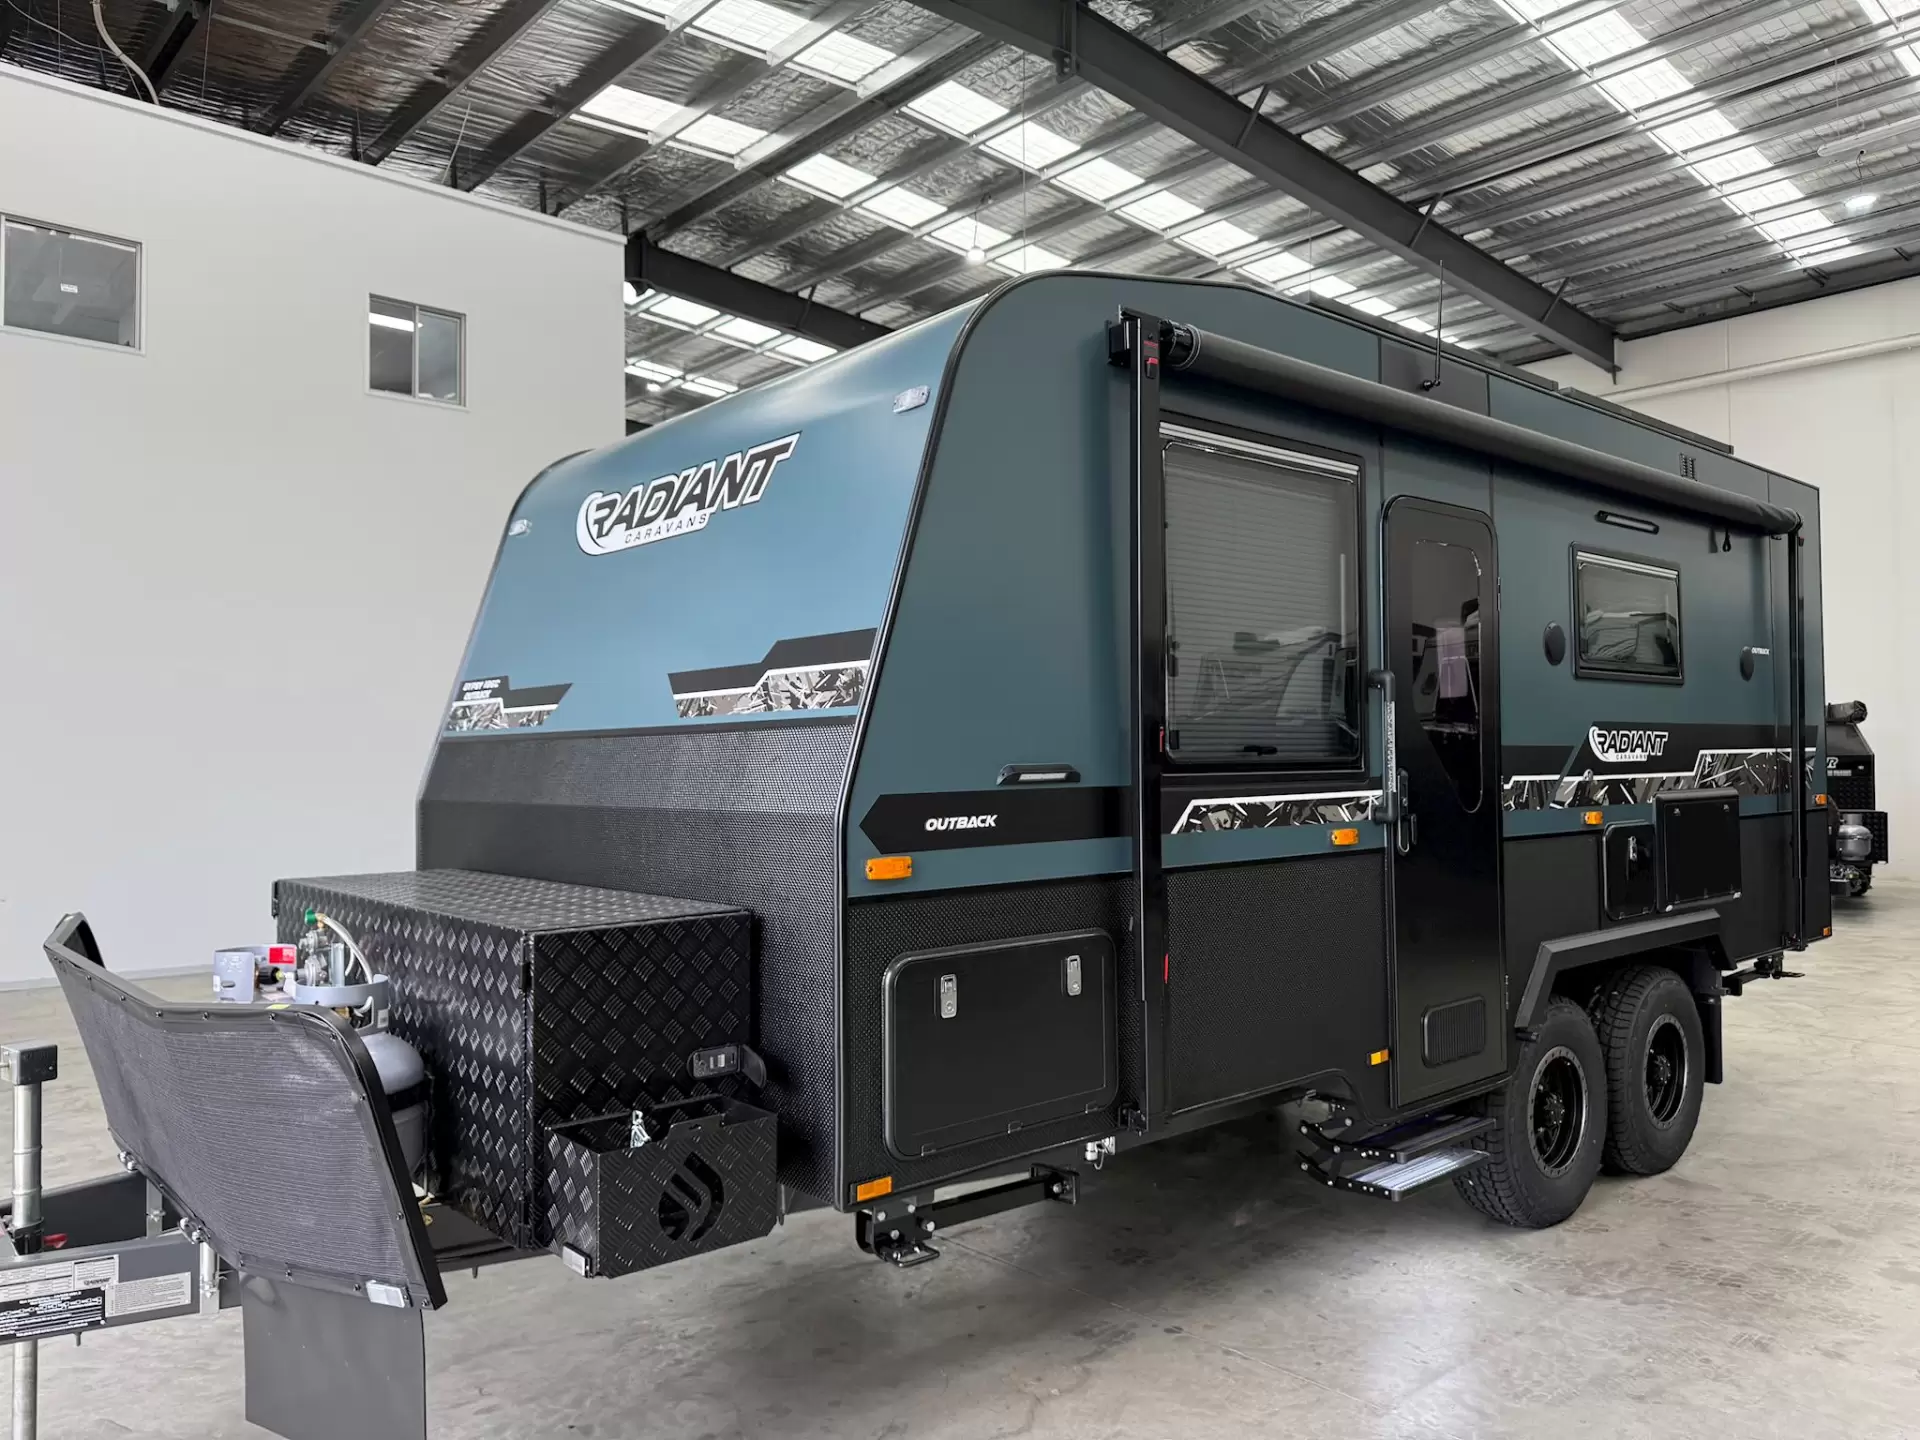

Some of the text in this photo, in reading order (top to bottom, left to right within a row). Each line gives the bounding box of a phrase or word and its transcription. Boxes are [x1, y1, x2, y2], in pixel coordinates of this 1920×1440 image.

[580, 432, 801, 540] RADIANT
[624, 512, 708, 545] CARAVANS
[1589, 726, 1669, 756] RADIANT
[924, 814, 998, 832] OUTBACK
